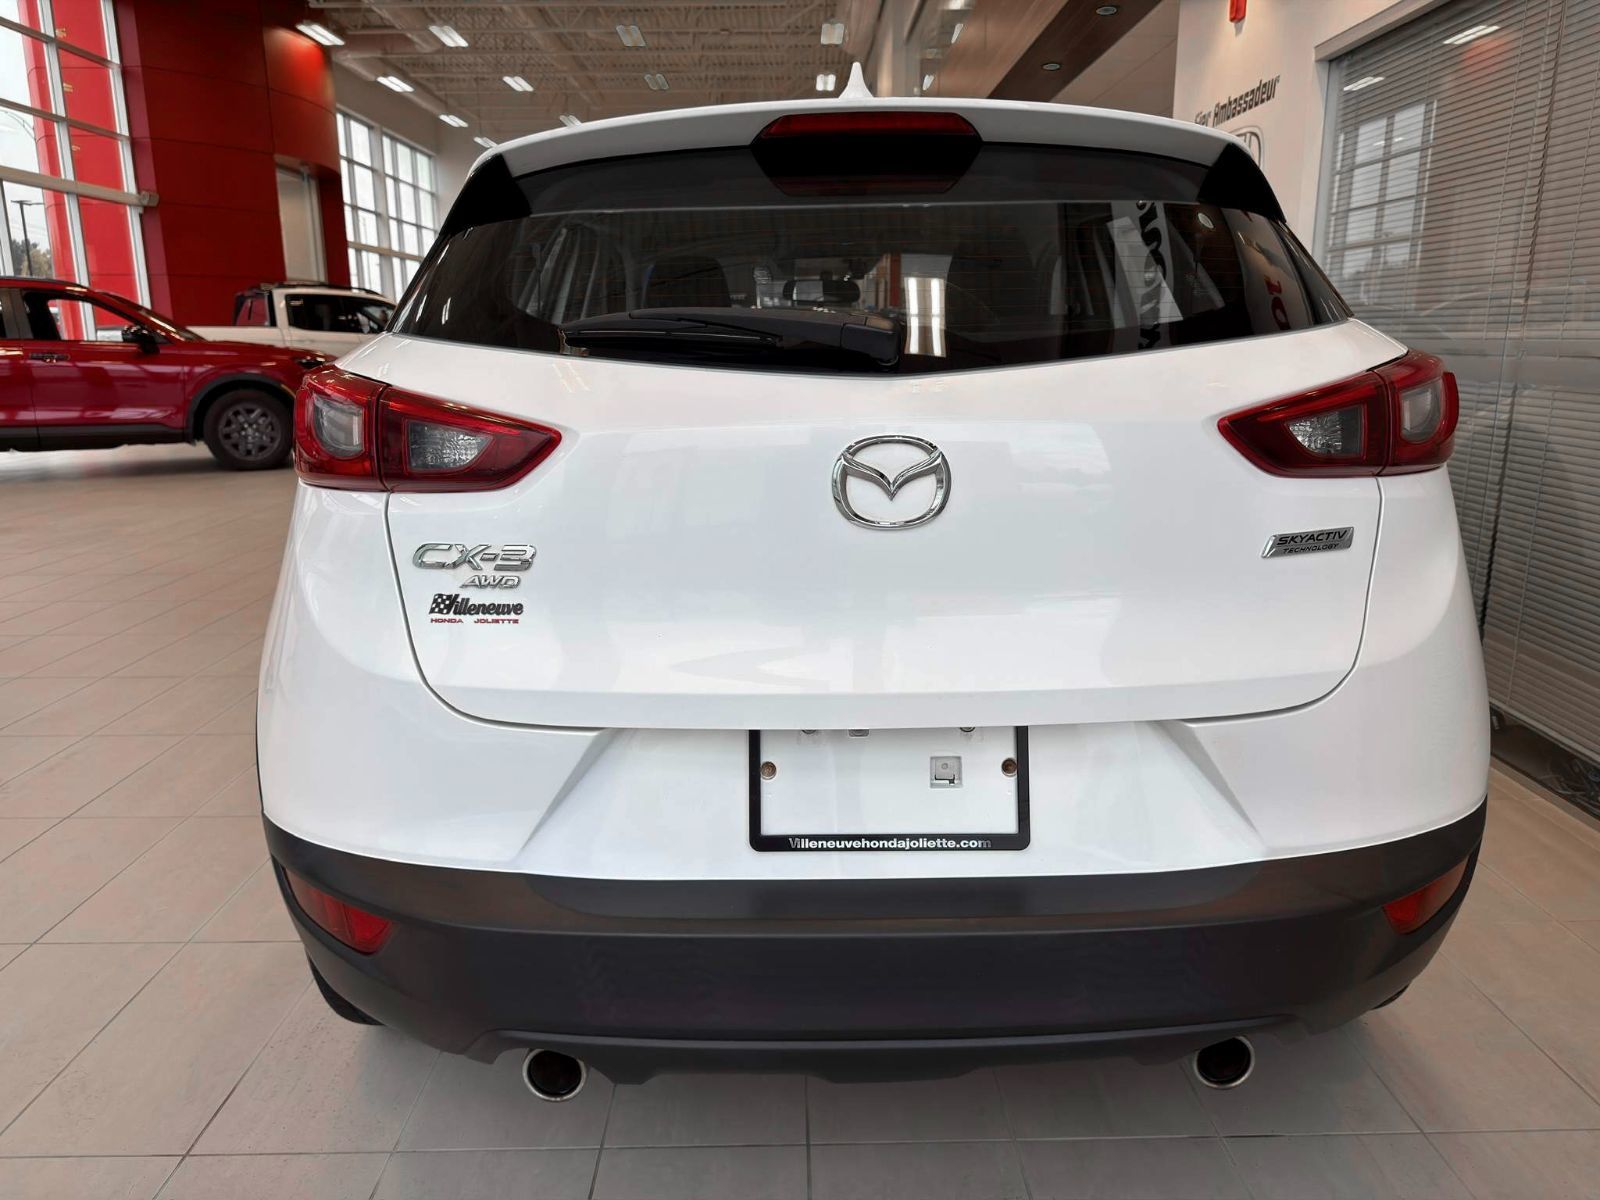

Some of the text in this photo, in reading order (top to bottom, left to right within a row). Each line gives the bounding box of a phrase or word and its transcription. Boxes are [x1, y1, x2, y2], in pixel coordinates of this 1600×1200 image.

[1212, 78, 1277, 127] Ambassadeur
[1277, 530, 1347, 545] SKYACTIV
[1283, 543, 1340, 554] TECHNOLOGY
[412, 542, 537, 571] CX-3
[459, 574, 522, 589] AWD
[438, 593, 524, 616] Villeneuve
[788, 837, 992, 850] Villeneuvehondajoliette.com
